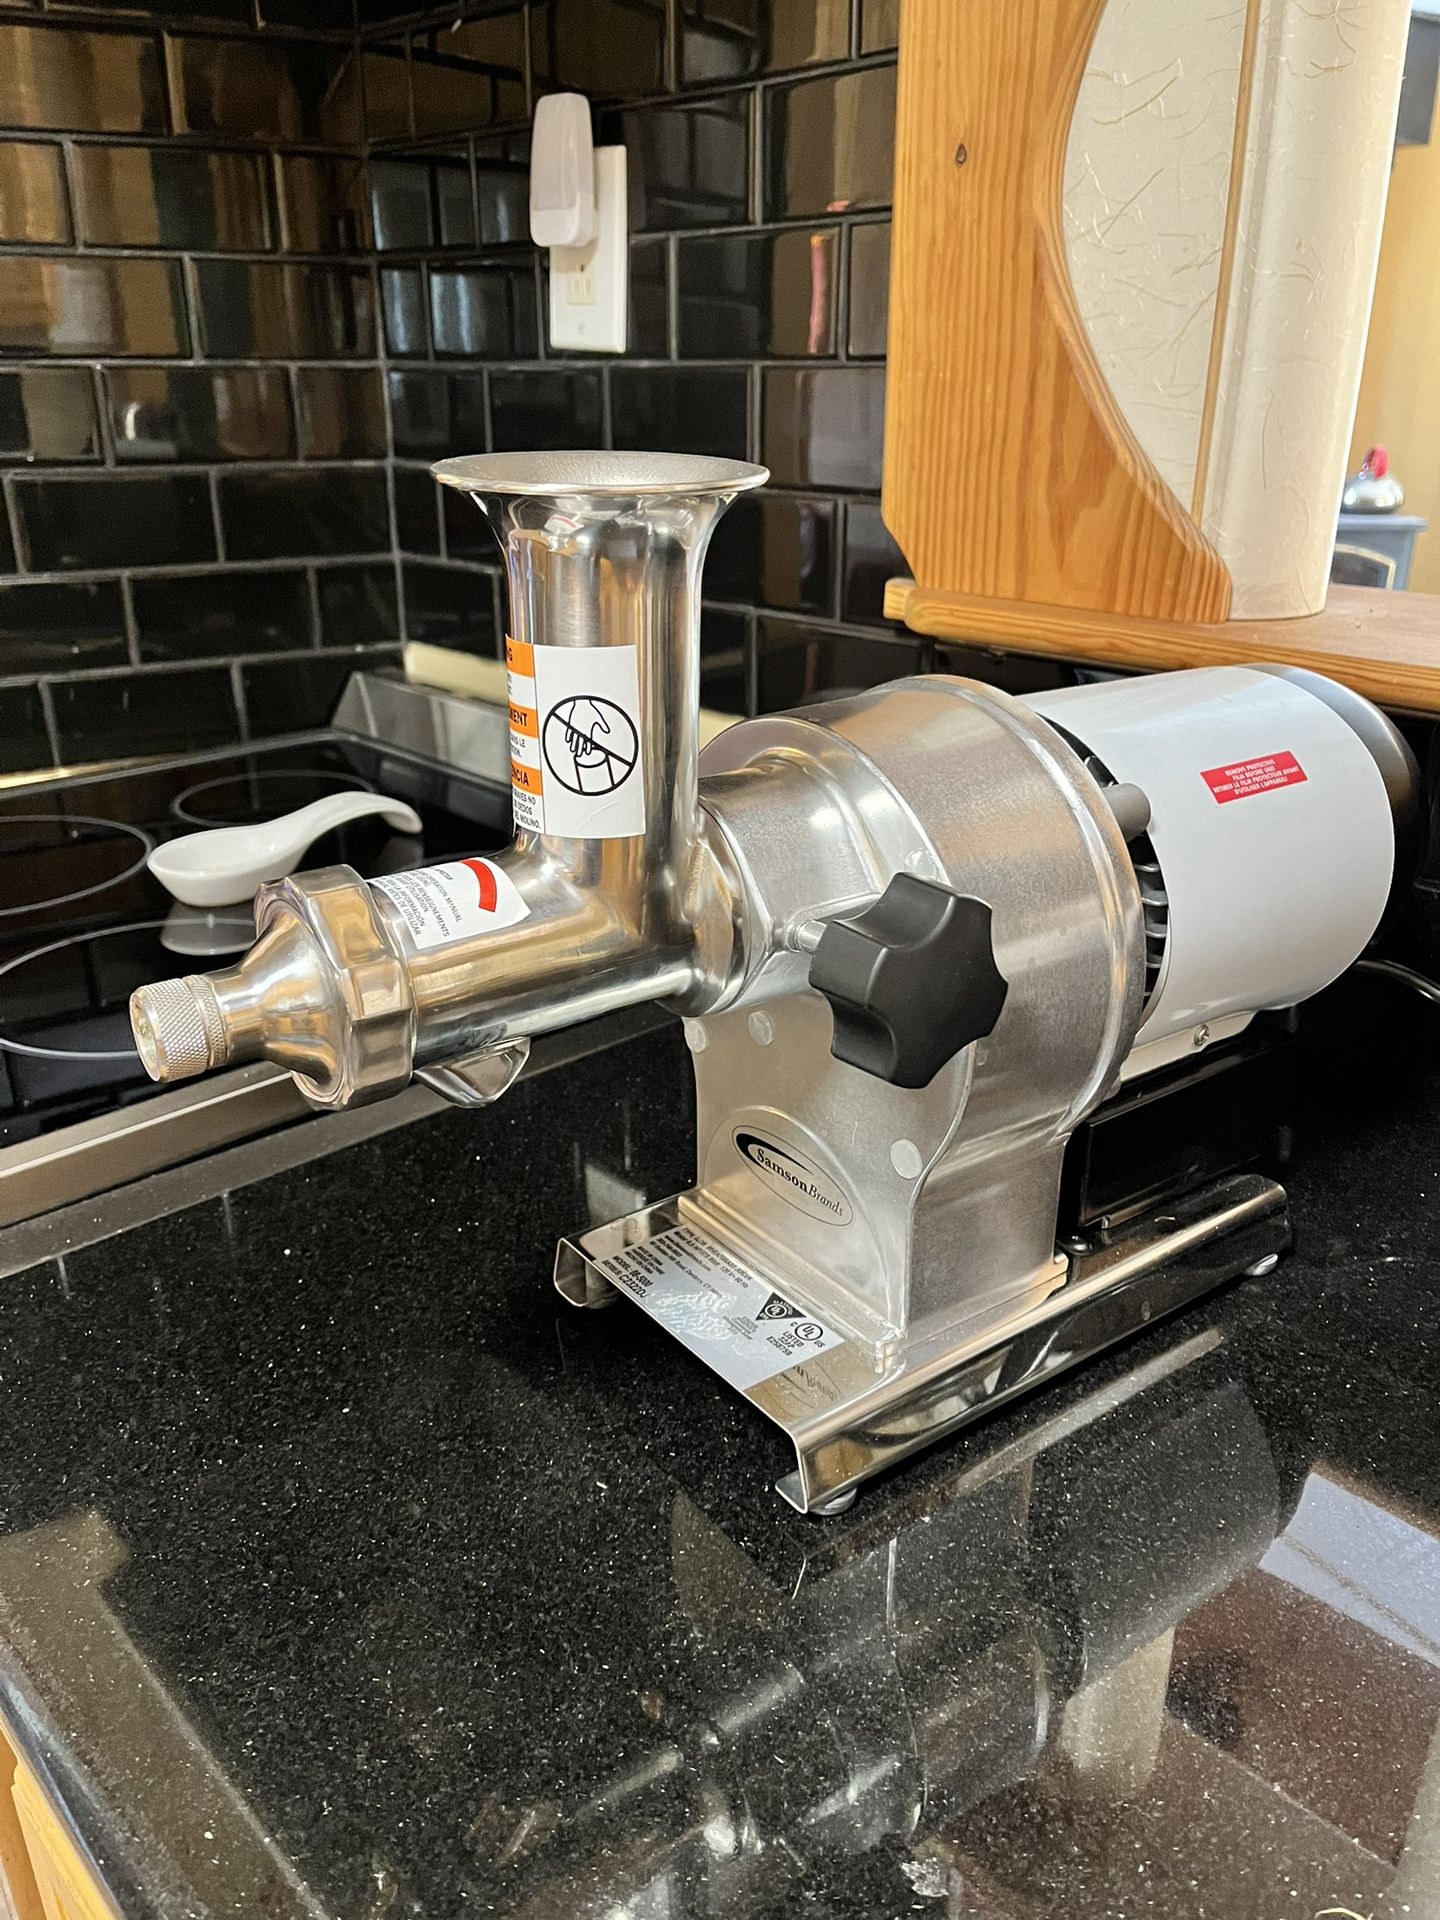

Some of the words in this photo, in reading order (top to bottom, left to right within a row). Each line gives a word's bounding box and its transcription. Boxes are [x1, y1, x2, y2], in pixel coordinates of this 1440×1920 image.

[1225, 766, 1246, 776] REMOVE
[1246, 759, 1275, 770] PROTECTIVE
[1245, 769, 1264, 777] BEFORE
[1213, 784, 1233, 793] RETIRER
[1252, 771, 1282, 782] PROTECTEUR
[1283, 766, 1299, 774] AVANT
[418, 887, 449, 936] RENSEIGNEMENTS
[445, 897, 461, 921] MANUAL
[757, 1148, 844, 1217] SamsonBrands
[782, 1331, 804, 1347] LISTED
[802, 1325, 814, 1338] UL
